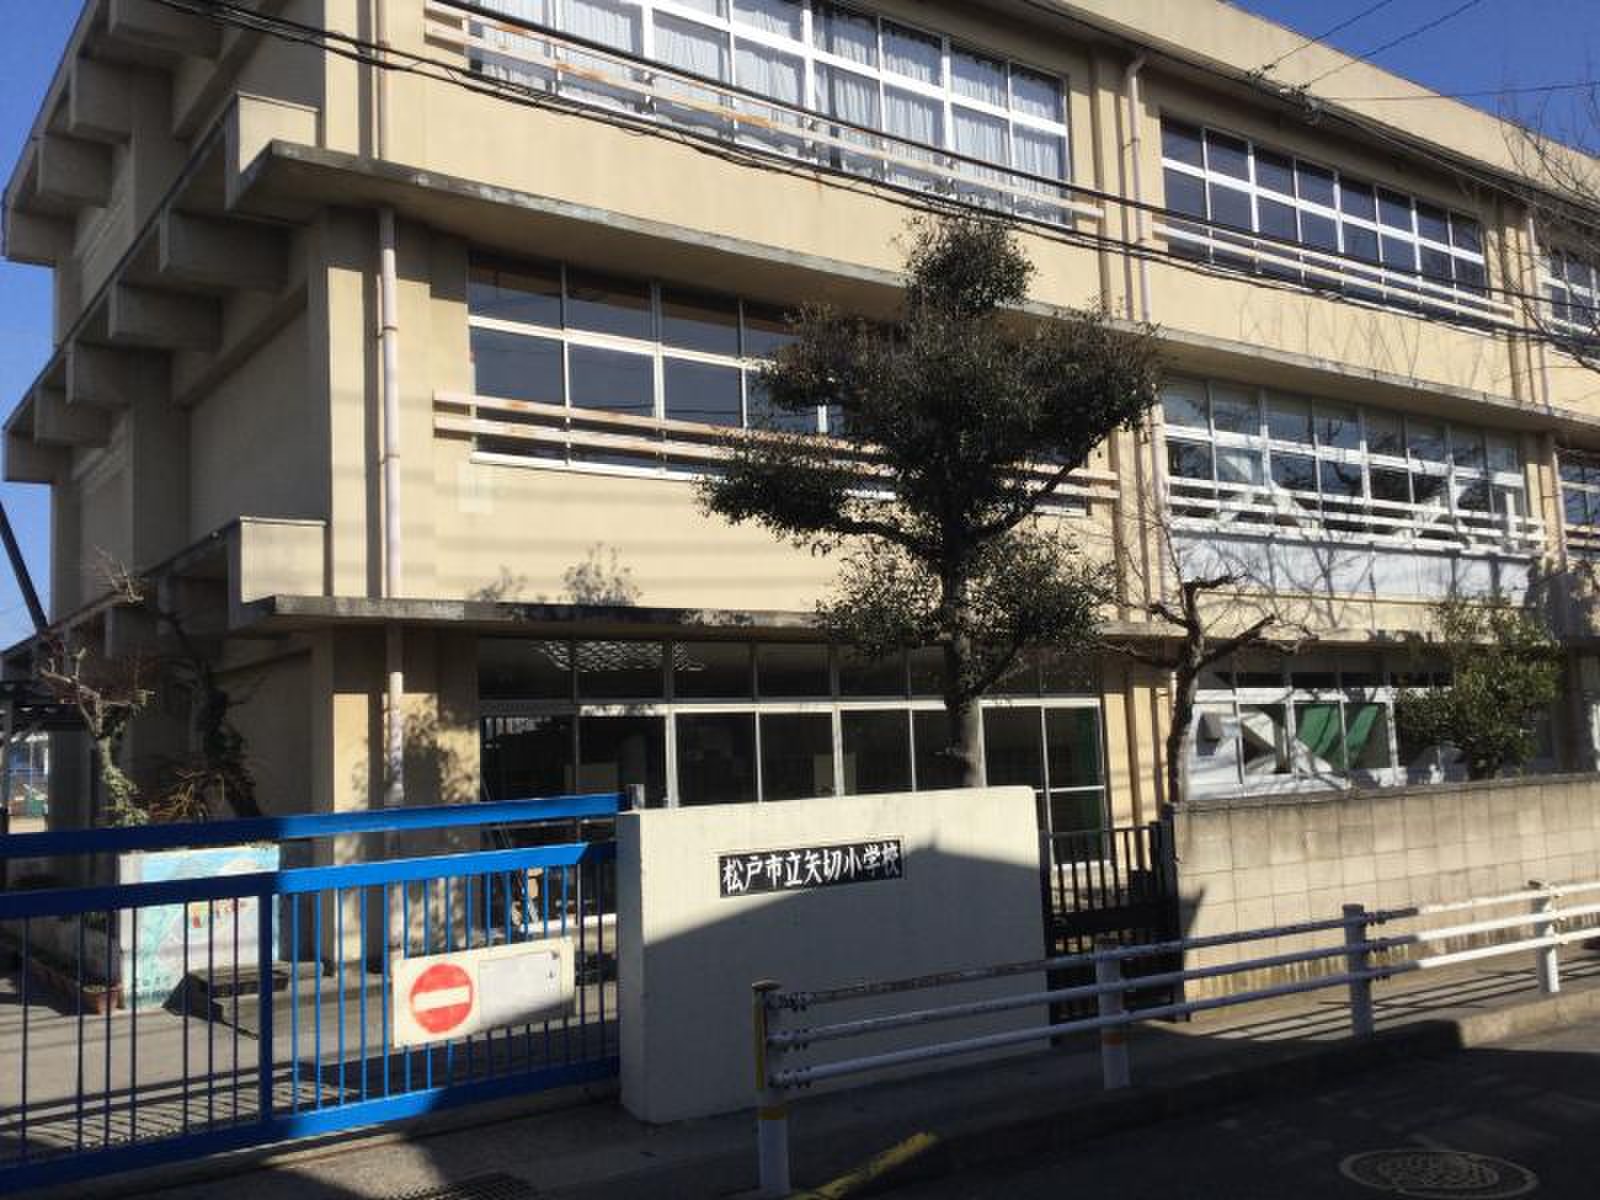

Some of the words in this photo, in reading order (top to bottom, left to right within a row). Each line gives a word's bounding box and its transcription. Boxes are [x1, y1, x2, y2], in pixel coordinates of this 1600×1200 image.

[722, 842, 900, 895] 松戸市立矢切小学校
